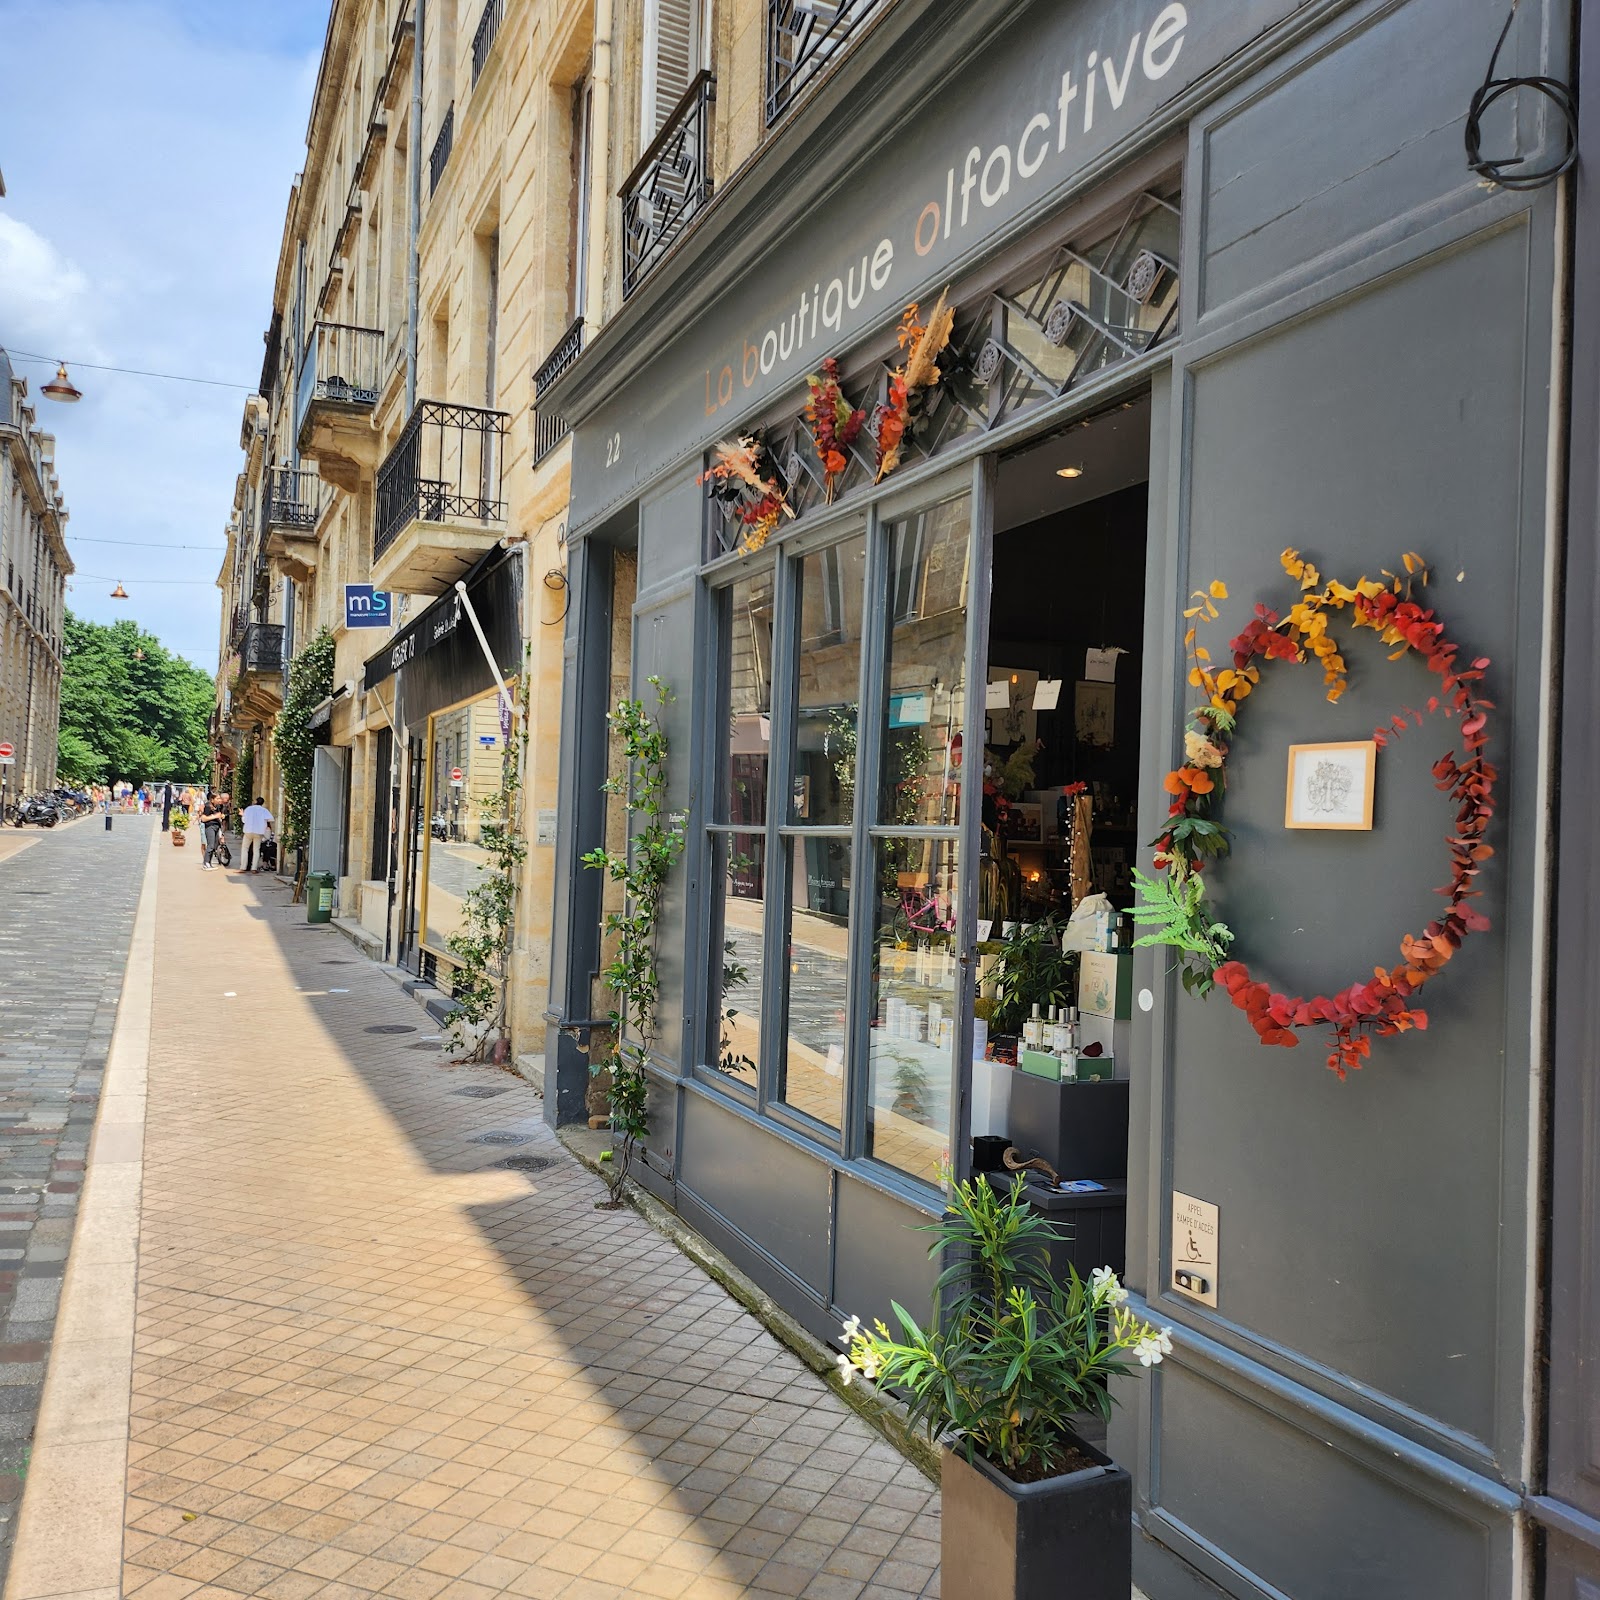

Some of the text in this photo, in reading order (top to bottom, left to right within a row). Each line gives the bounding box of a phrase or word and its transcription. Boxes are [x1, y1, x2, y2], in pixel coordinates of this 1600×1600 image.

[704, 2, 1188, 416] La boutique olfactive
[606, 432, 621, 468] 22
[1176, 1212, 1193, 1228] RAMPE
[1188, 1203, 1203, 1217] APPEL
